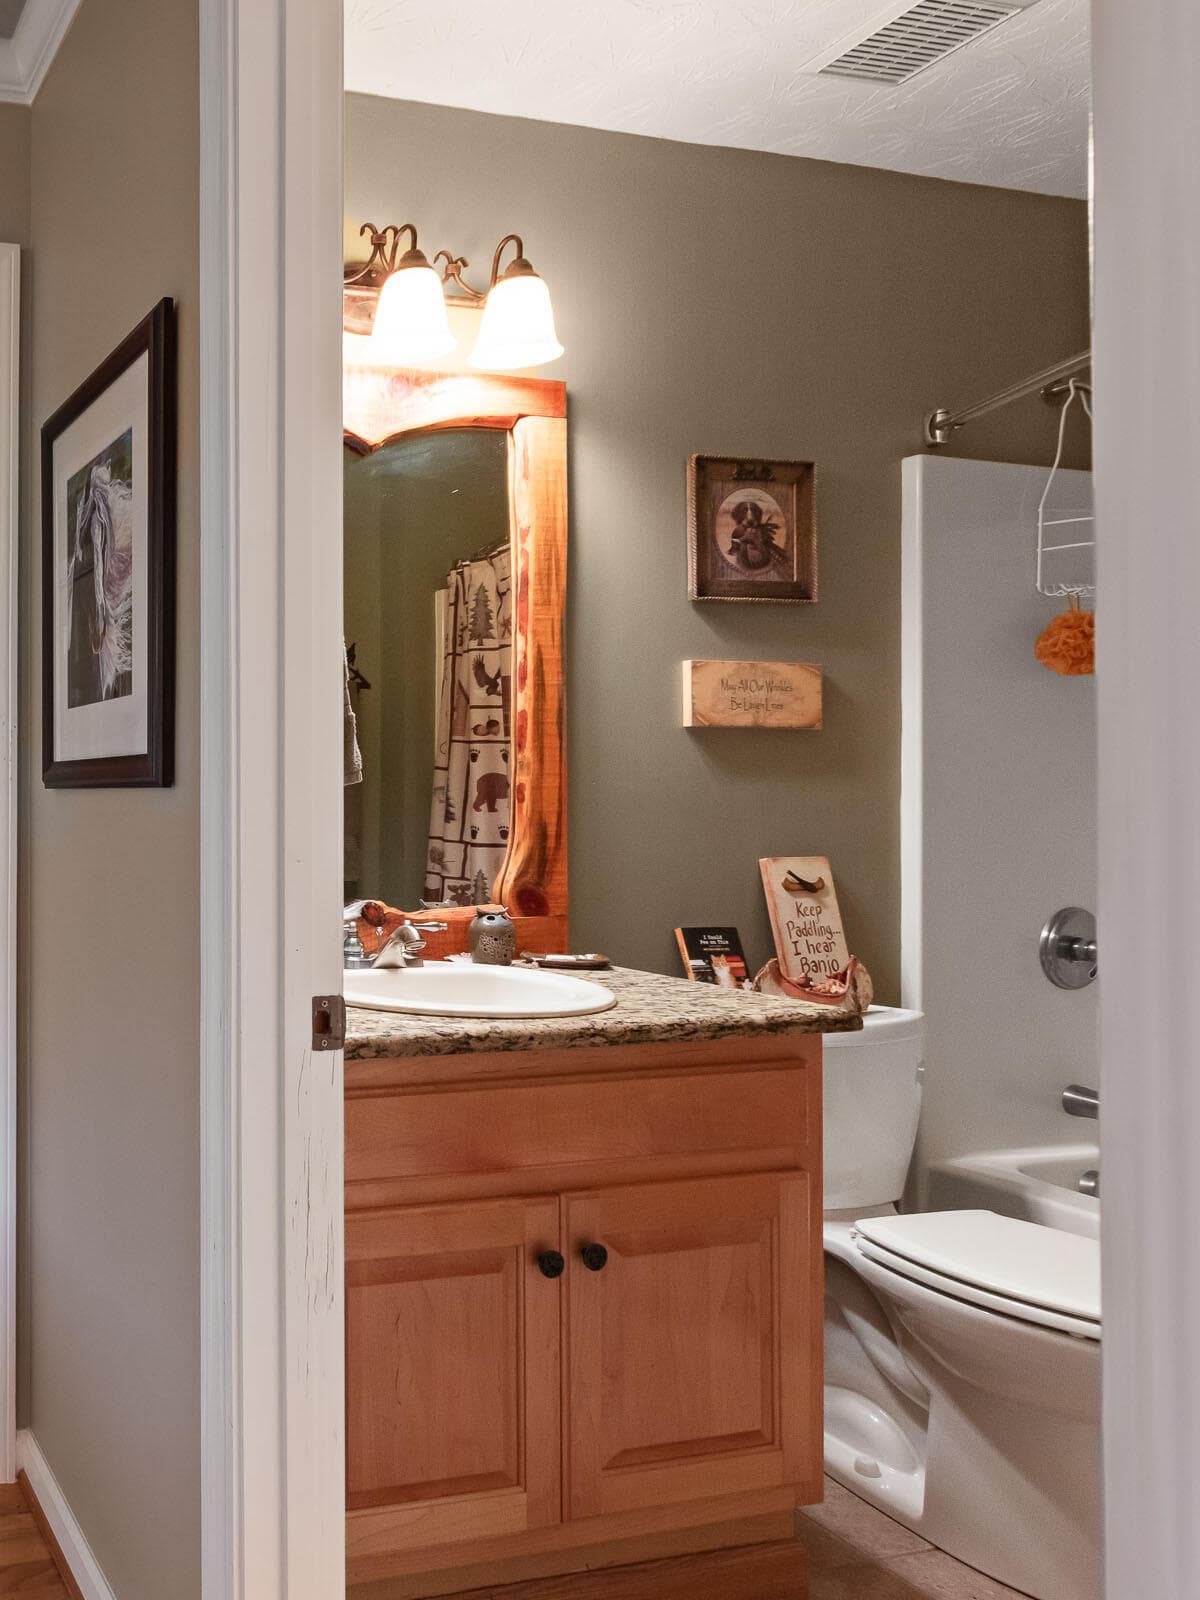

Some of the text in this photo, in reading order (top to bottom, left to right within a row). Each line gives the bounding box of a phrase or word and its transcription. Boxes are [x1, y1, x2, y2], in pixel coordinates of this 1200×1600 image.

[796, 902, 822, 923] Keep
[786, 921, 841, 940] Paddling...
[792, 940, 836, 956] I hear
[800, 955, 839, 976] Banjo
